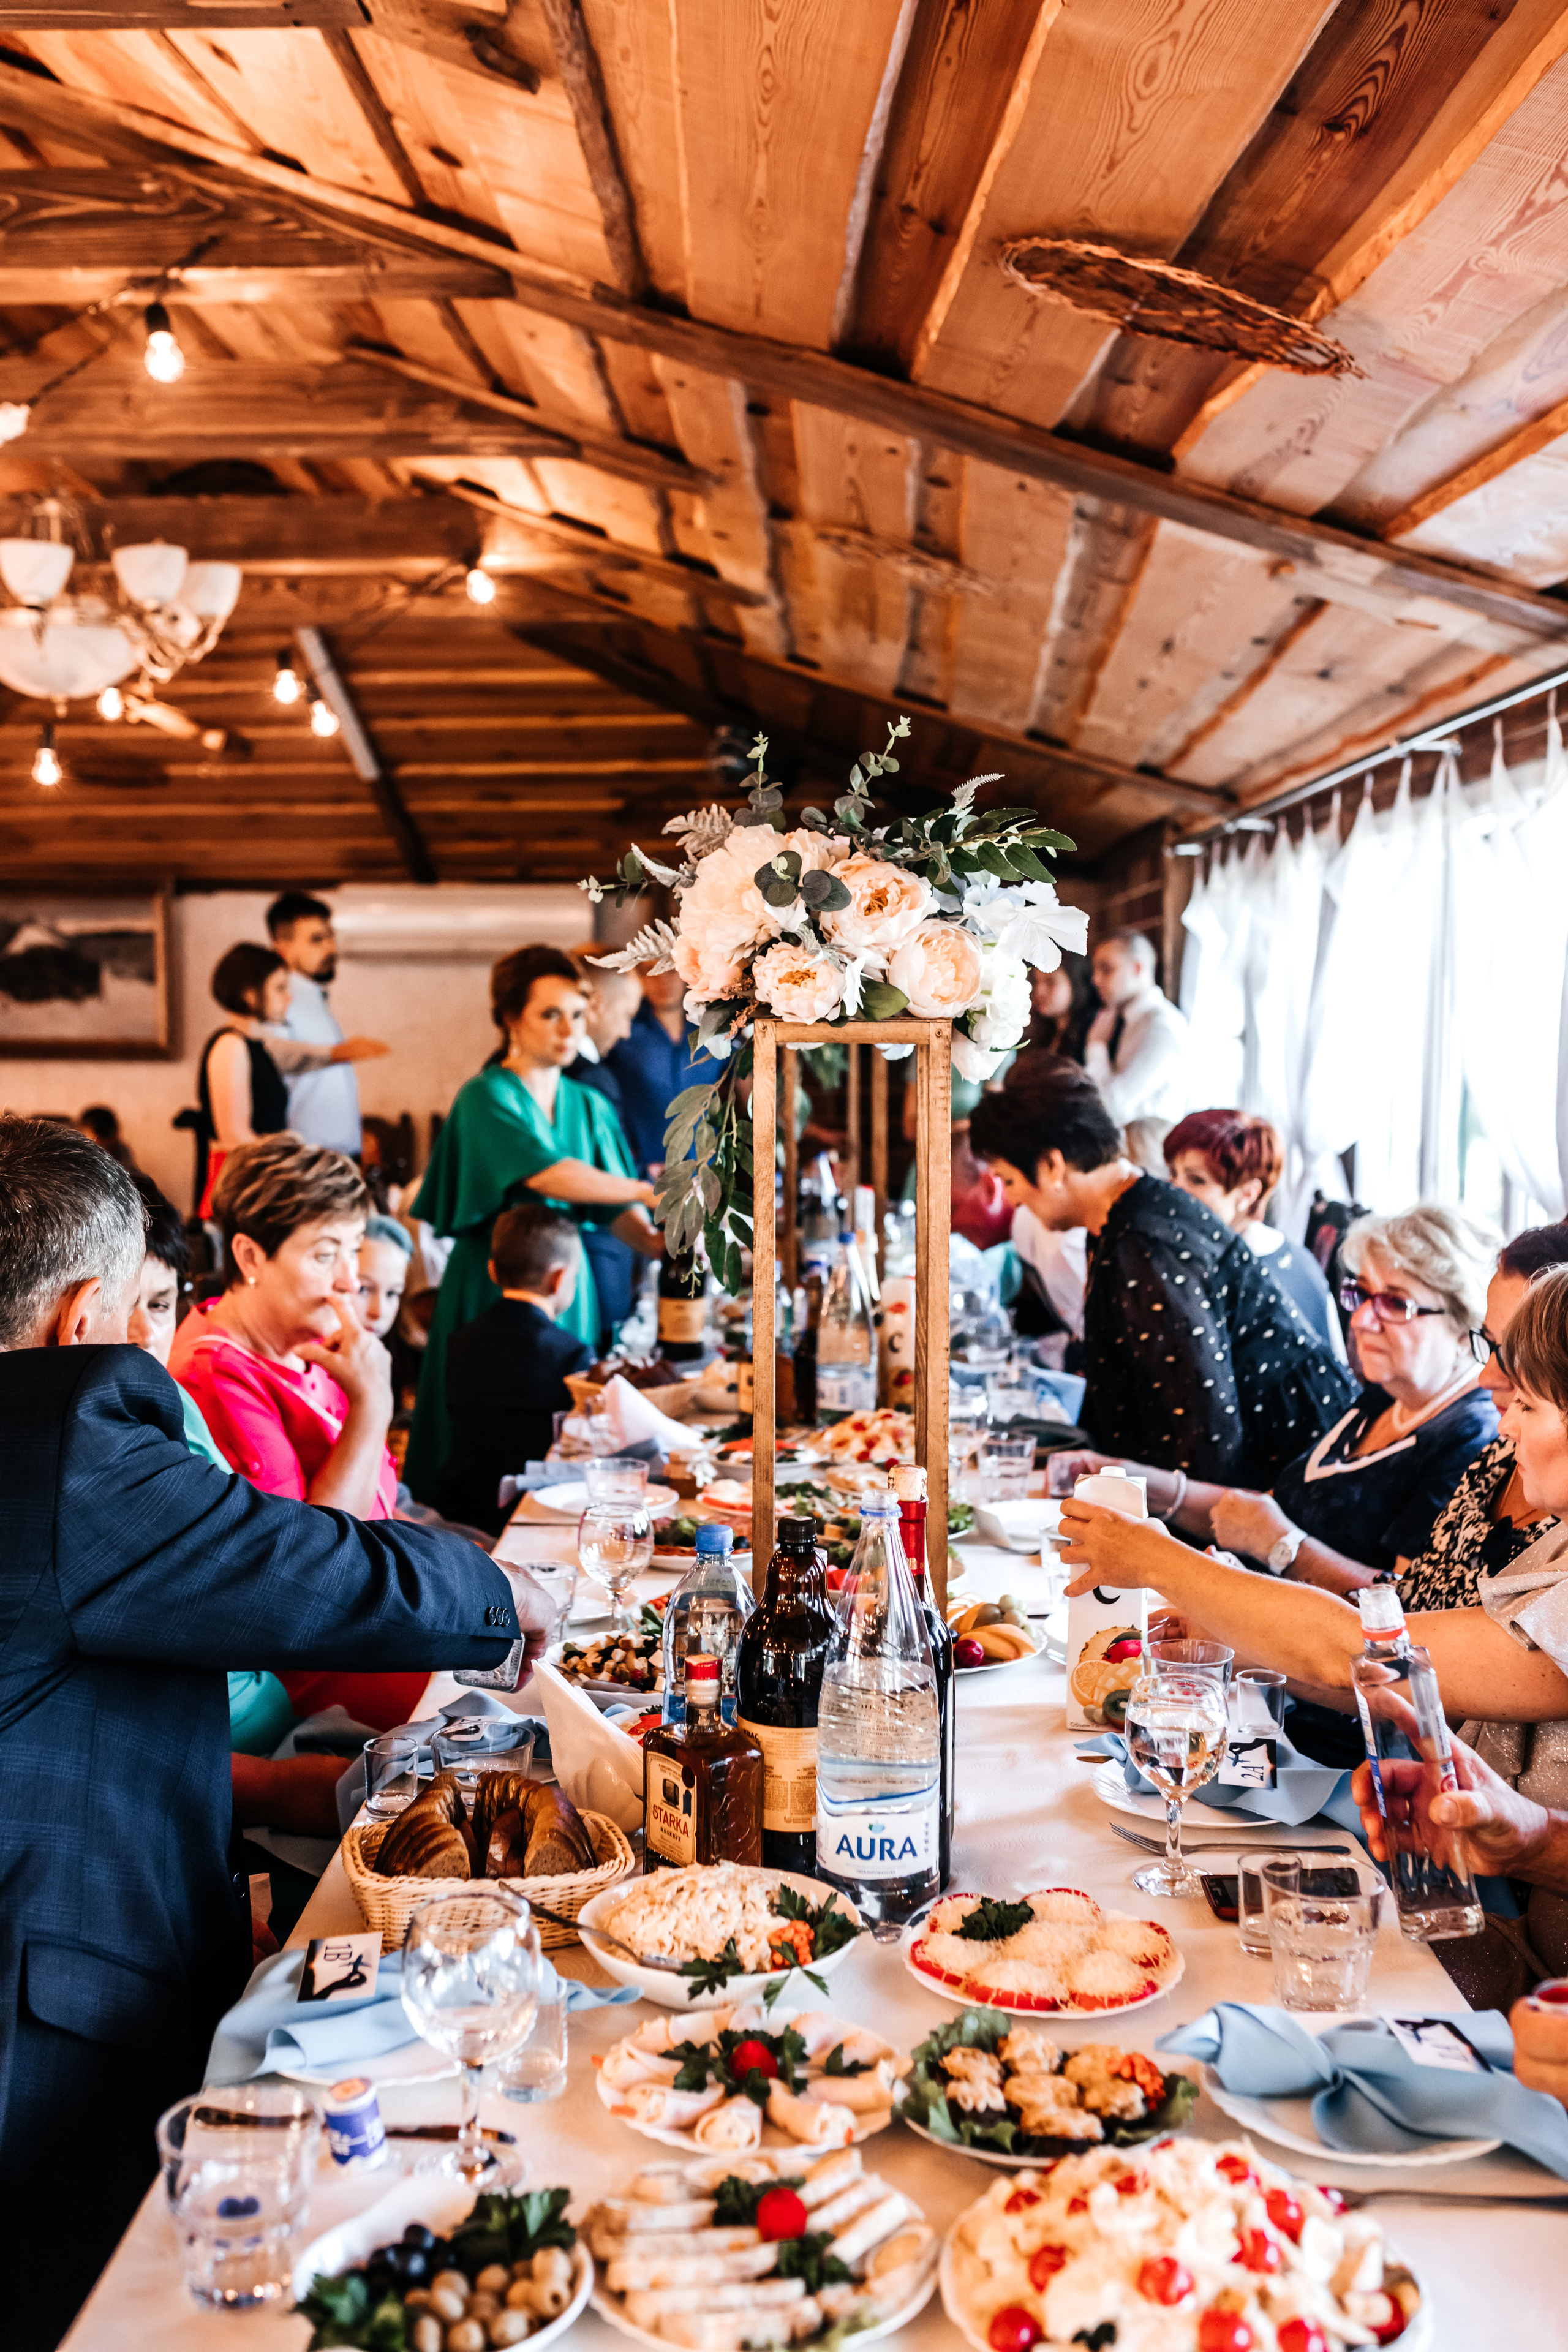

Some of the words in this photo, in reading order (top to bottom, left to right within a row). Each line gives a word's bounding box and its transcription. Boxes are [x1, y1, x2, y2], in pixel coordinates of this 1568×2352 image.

[1240, 1766, 1264, 1782] 2A
[652, 1804, 689, 1838] STARKA
[660, 1826, 681, 1842] RESERVE
[835, 1834, 918, 1861] AURA
[323, 1943, 353, 1962] 1B
